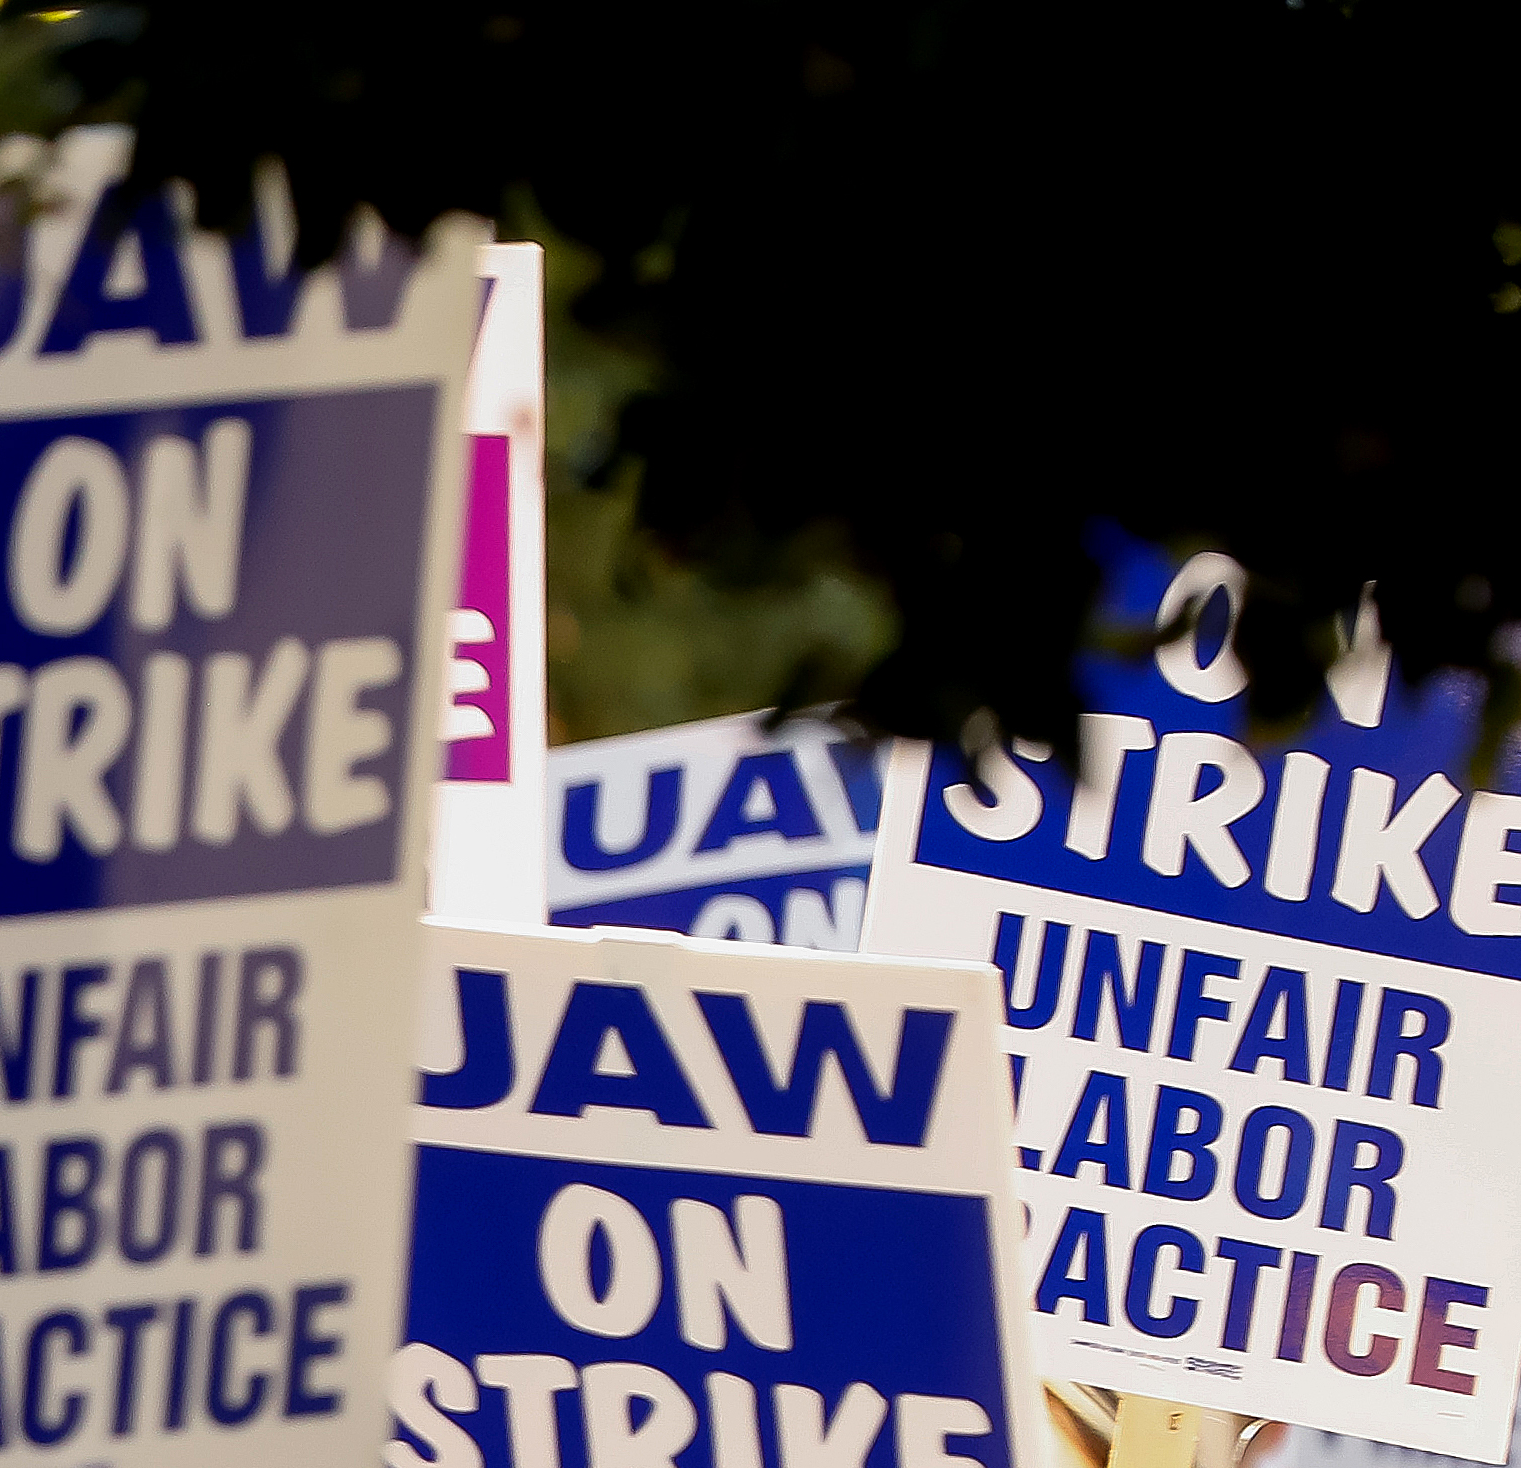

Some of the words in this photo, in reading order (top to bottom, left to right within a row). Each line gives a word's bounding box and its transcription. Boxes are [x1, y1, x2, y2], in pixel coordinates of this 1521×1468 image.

[3, 417, 255, 638] ON
[992, 910, 1452, 1109] UNFAIR
[537, 1183, 794, 1352] ON
[1024, 1203, 1493, 1398] ACTICE
